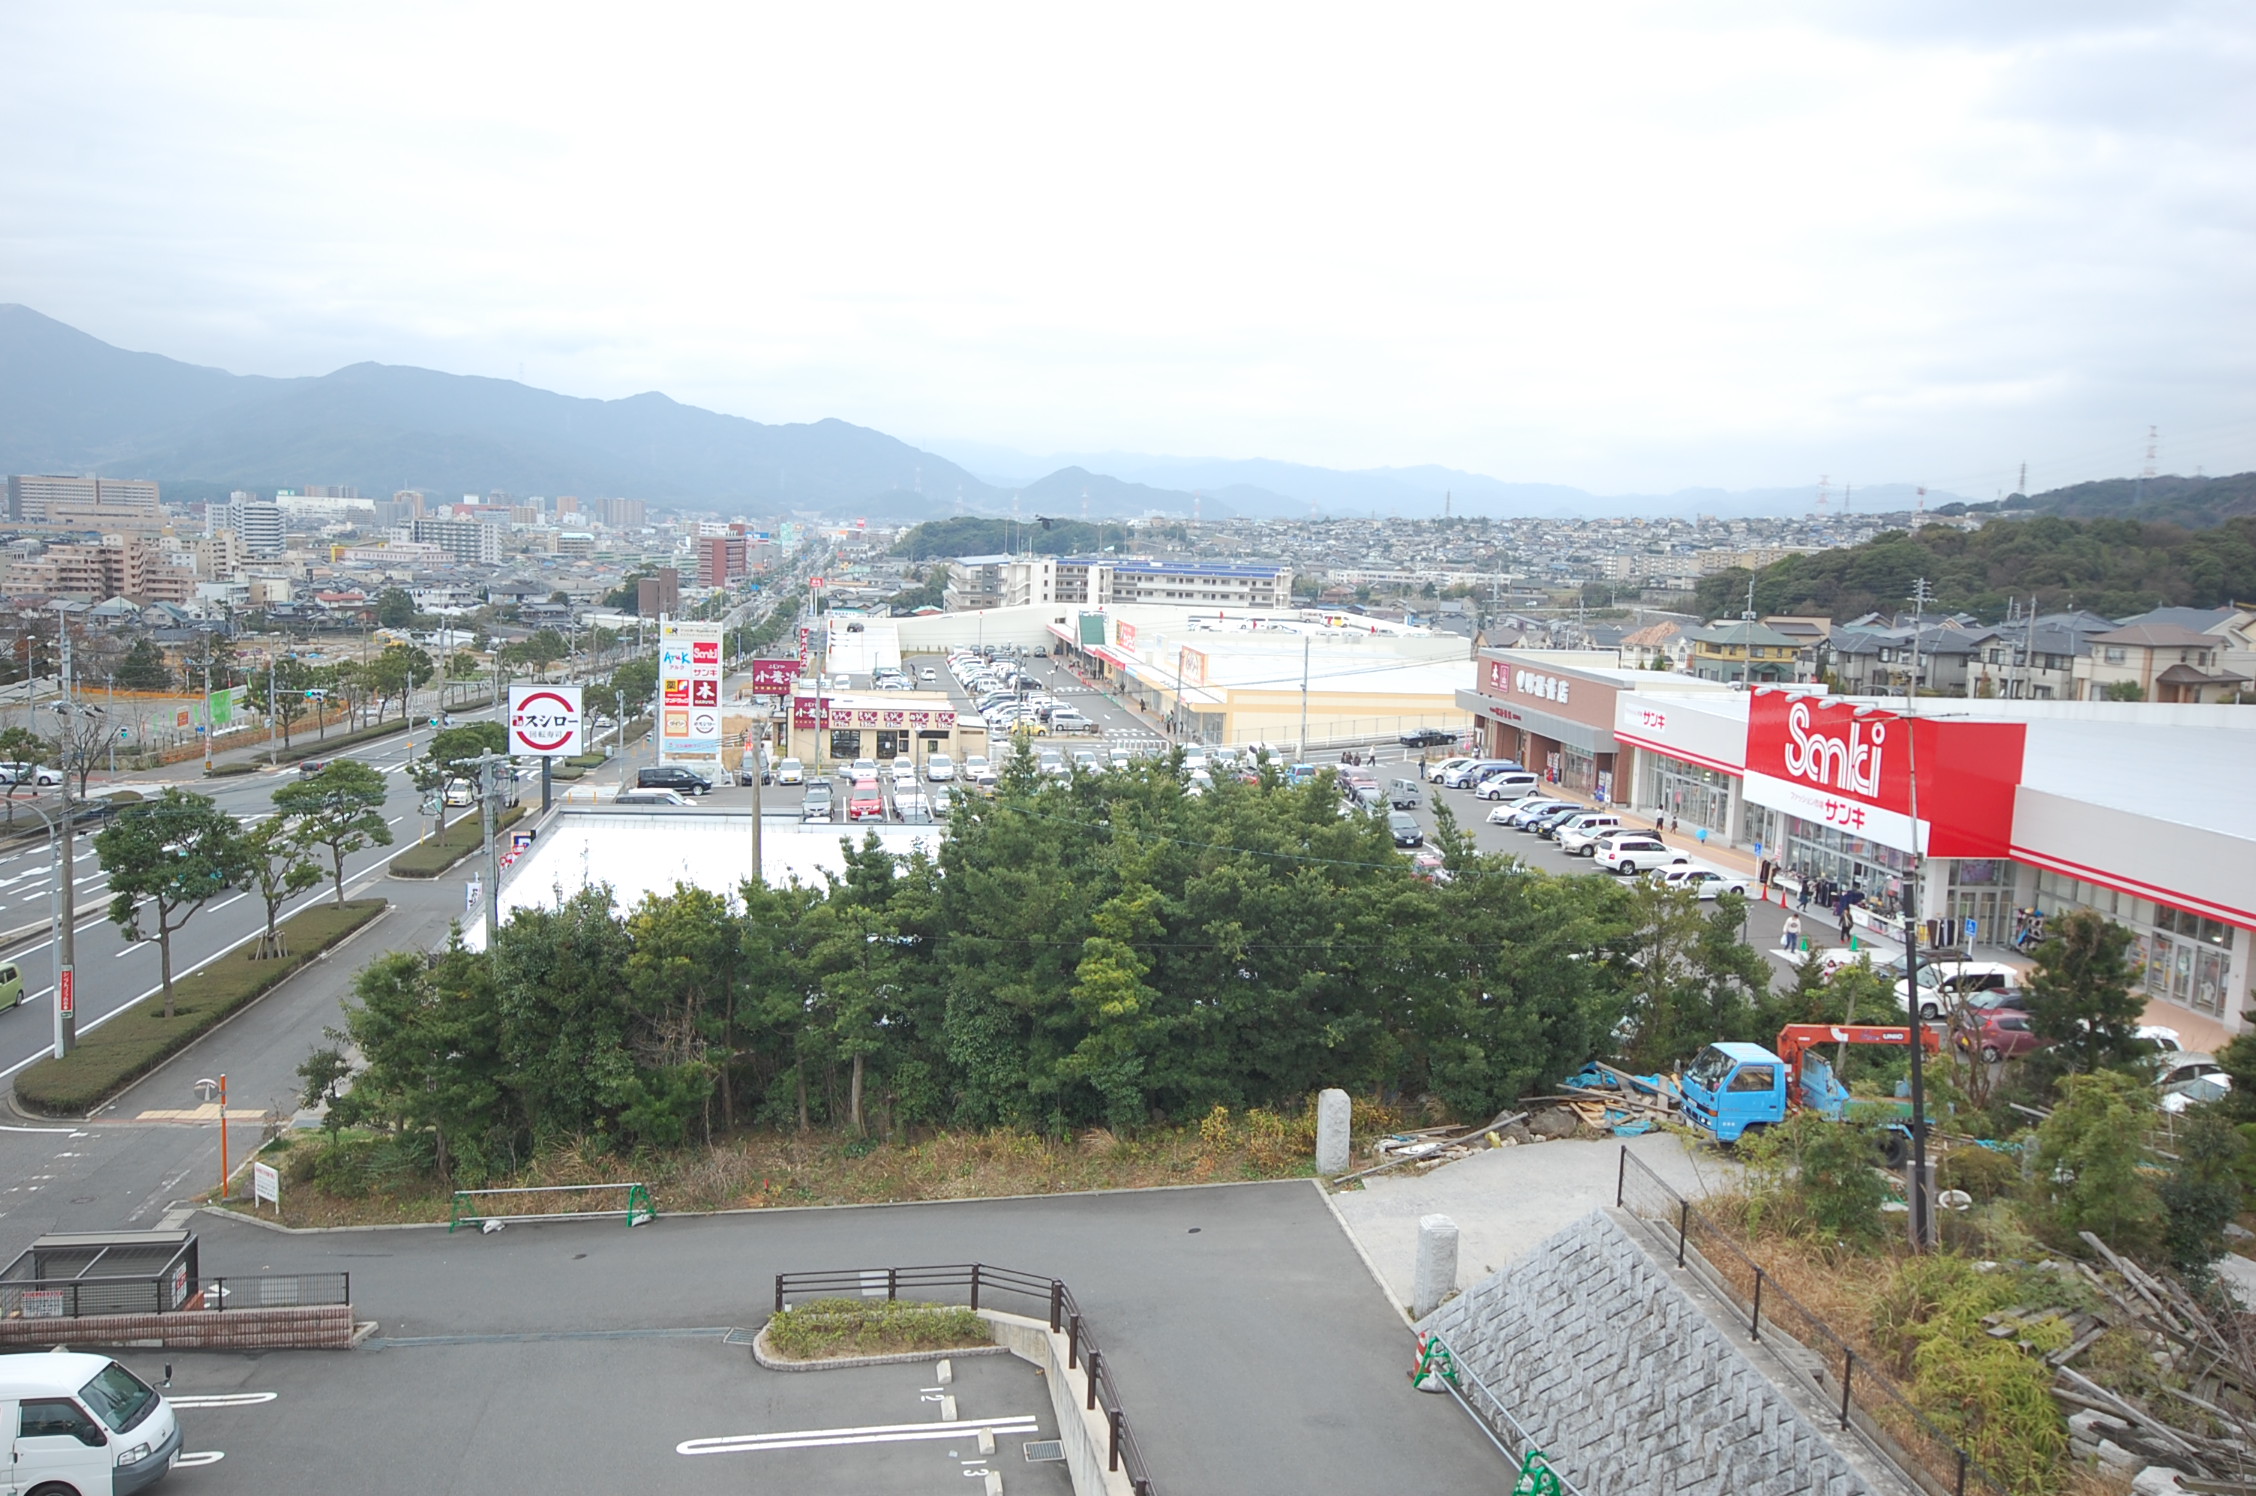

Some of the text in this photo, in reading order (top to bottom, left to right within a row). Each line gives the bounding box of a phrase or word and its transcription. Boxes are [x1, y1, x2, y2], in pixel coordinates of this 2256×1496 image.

[694, 647, 717, 659] Sanki
[693, 669, 717, 677] サンキ
[525, 715, 579, 728] スシロー
[1643, 710, 1665, 730] サンキ
[529, 730, 563, 739] 回転寿司
[1785, 702, 1886, 798] Sanki
[1825, 799, 1866, 830] サンキ
[961, 1460, 990, 1478] 13
